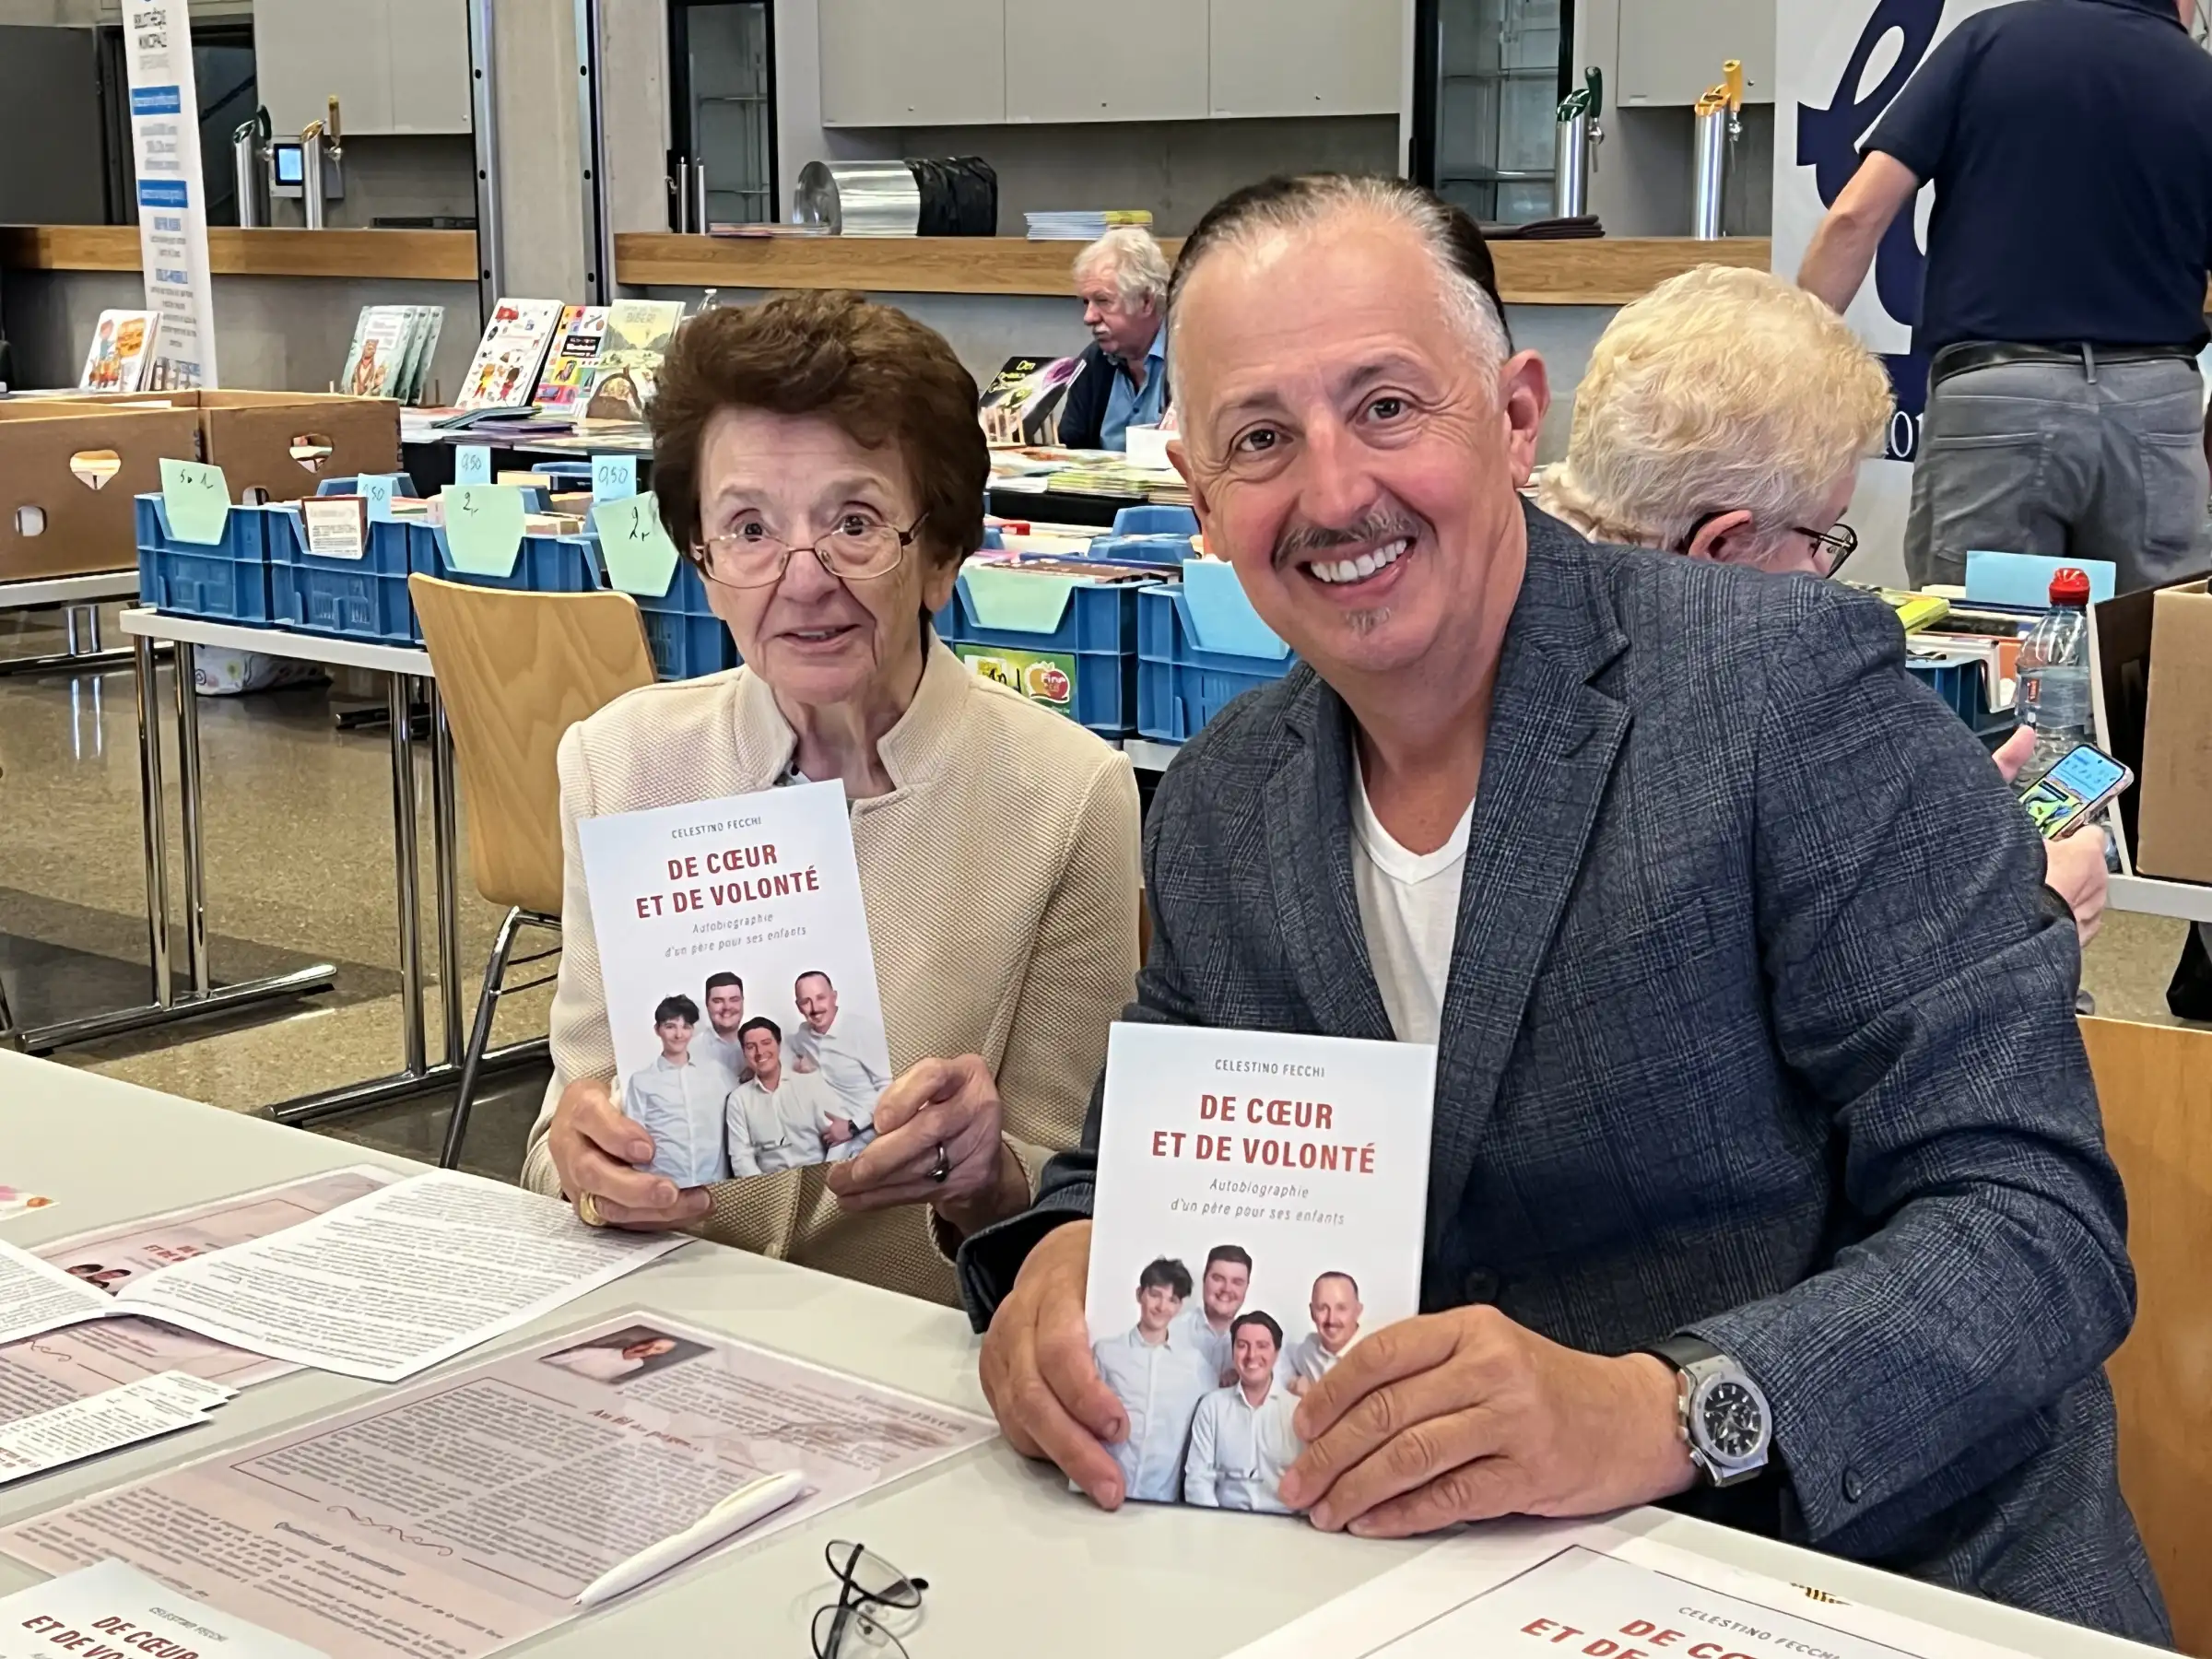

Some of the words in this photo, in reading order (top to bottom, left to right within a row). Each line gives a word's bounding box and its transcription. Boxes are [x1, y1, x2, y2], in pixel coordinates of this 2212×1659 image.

[598, 465, 629, 485] 0,50
[671, 822, 724, 839] CELESTINO
[726, 817, 762, 831] FECCHI
[667, 856, 700, 881] DE
[706, 843, 778, 875] CŒUR
[636, 895, 665, 919] ET
[672, 888, 704, 914] DE
[710, 865, 820, 907] VOLONTÉ
[692, 912, 774, 934] Autobiographie
[746, 933, 764, 945] ses
[767, 925, 807, 941] enfants
[1215, 1059, 1279, 1075] CELESTINO
[1282, 1064, 1325, 1078] FECCHI
[1200, 1094, 1237, 1123] DE
[1247, 1098, 1334, 1130] CŒUR
[1152, 1130, 1187, 1159] ET
[1195, 1135, 1232, 1163] DE
[1242, 1138, 1377, 1174] VOLONTÉ
[1209, 1178, 1310, 1199] Autobiographie
[1235, 1204, 1265, 1219] pour
[1270, 1208, 1290, 1221] ses
[1296, 1209, 1346, 1227] enfants
[21, 1615, 65, 1634] ET
[49, 1630, 96, 1651] DE
[90, 1616, 137, 1636] DE
[1520, 1618, 1585, 1643] ET
[1618, 1618, 1687, 1648] DE
[1678, 1606, 1772, 1641] CELESTINO
